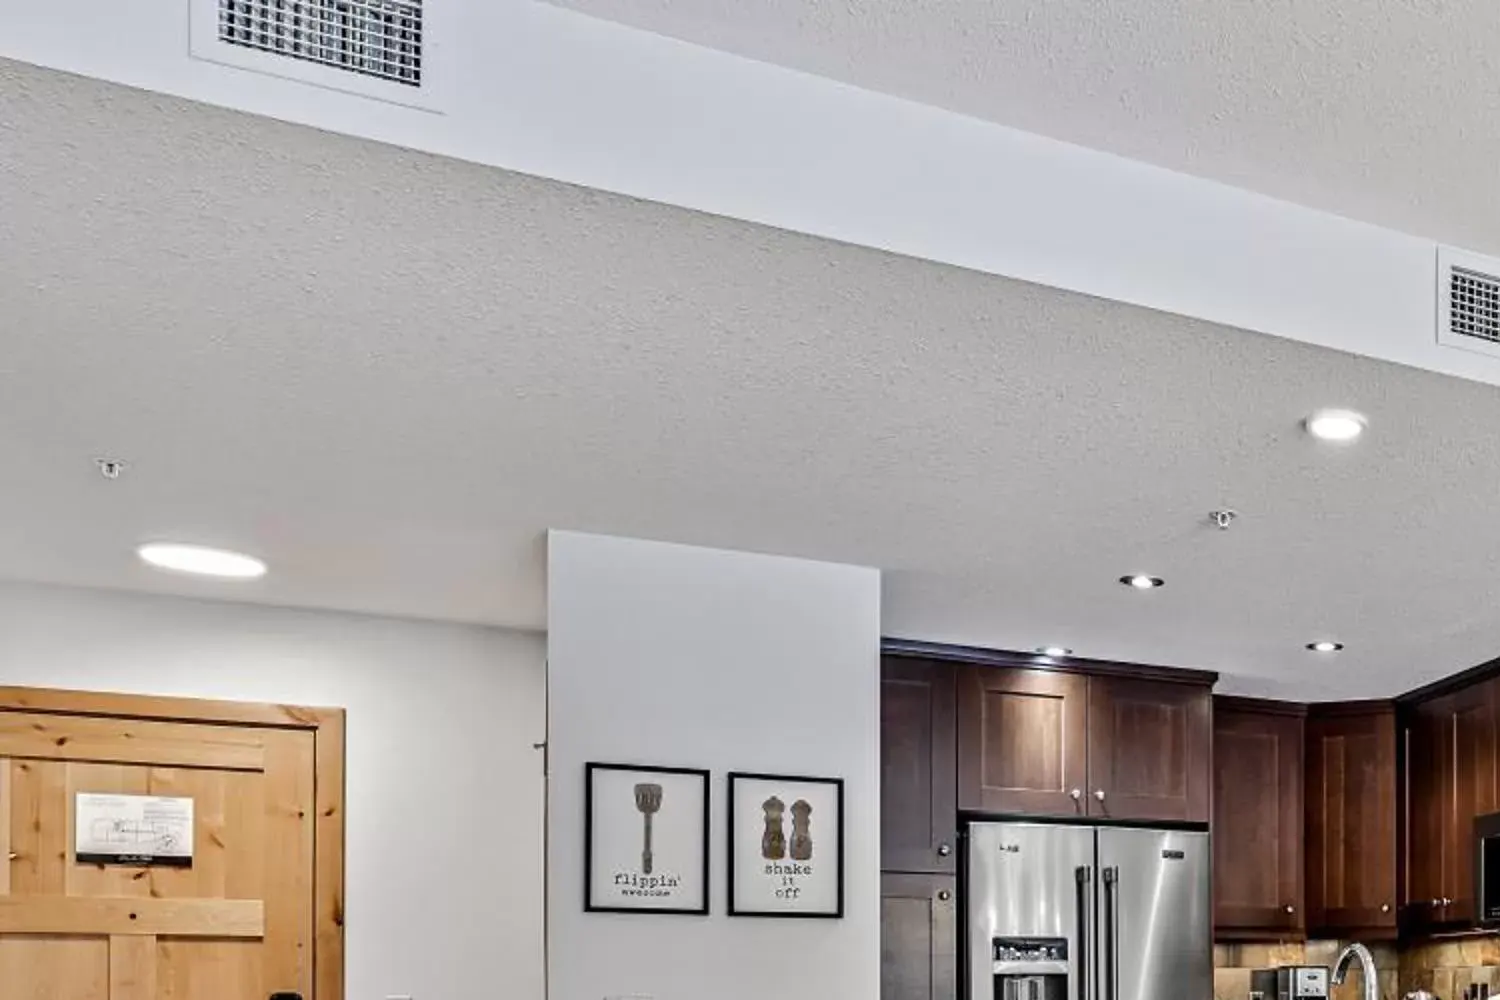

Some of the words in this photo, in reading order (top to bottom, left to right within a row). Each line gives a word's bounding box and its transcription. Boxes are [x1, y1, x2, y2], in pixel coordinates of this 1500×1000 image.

[765, 862, 813, 875] shake
[613, 873, 681, 889] flippin'
[782, 876, 794, 886] it
[775, 887, 801, 899] off
